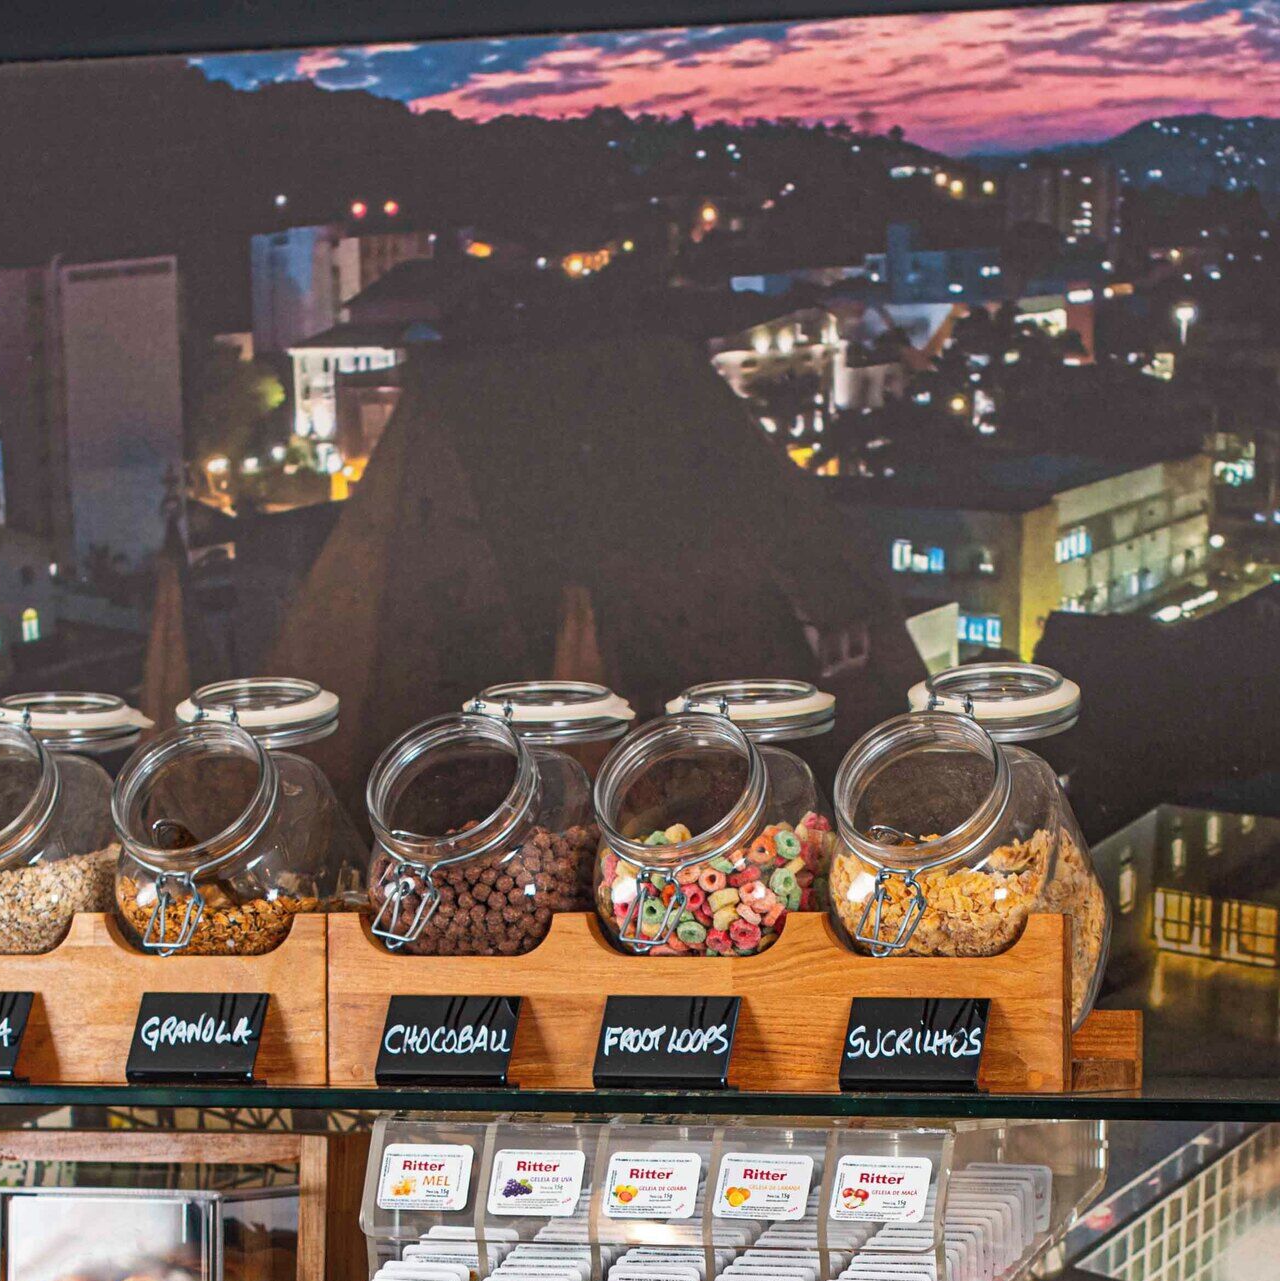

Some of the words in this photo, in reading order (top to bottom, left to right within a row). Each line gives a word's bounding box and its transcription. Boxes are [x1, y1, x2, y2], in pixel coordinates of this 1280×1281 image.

[141, 1012, 253, 1052] GRANOLA
[604, 1025, 666, 1056] FROOT
[667, 1023, 729, 1055] LOOPS
[847, 1020, 981, 1059] SUCRILHOS
[402, 1160, 445, 1171] Ritter
[516, 1161, 560, 1172] Ritter
[629, 1168, 674, 1179] Ritter
[742, 1168, 787, 1181] Ritter
[859, 1173, 905, 1184] Ritter
[422, 1175, 451, 1186] MEL
